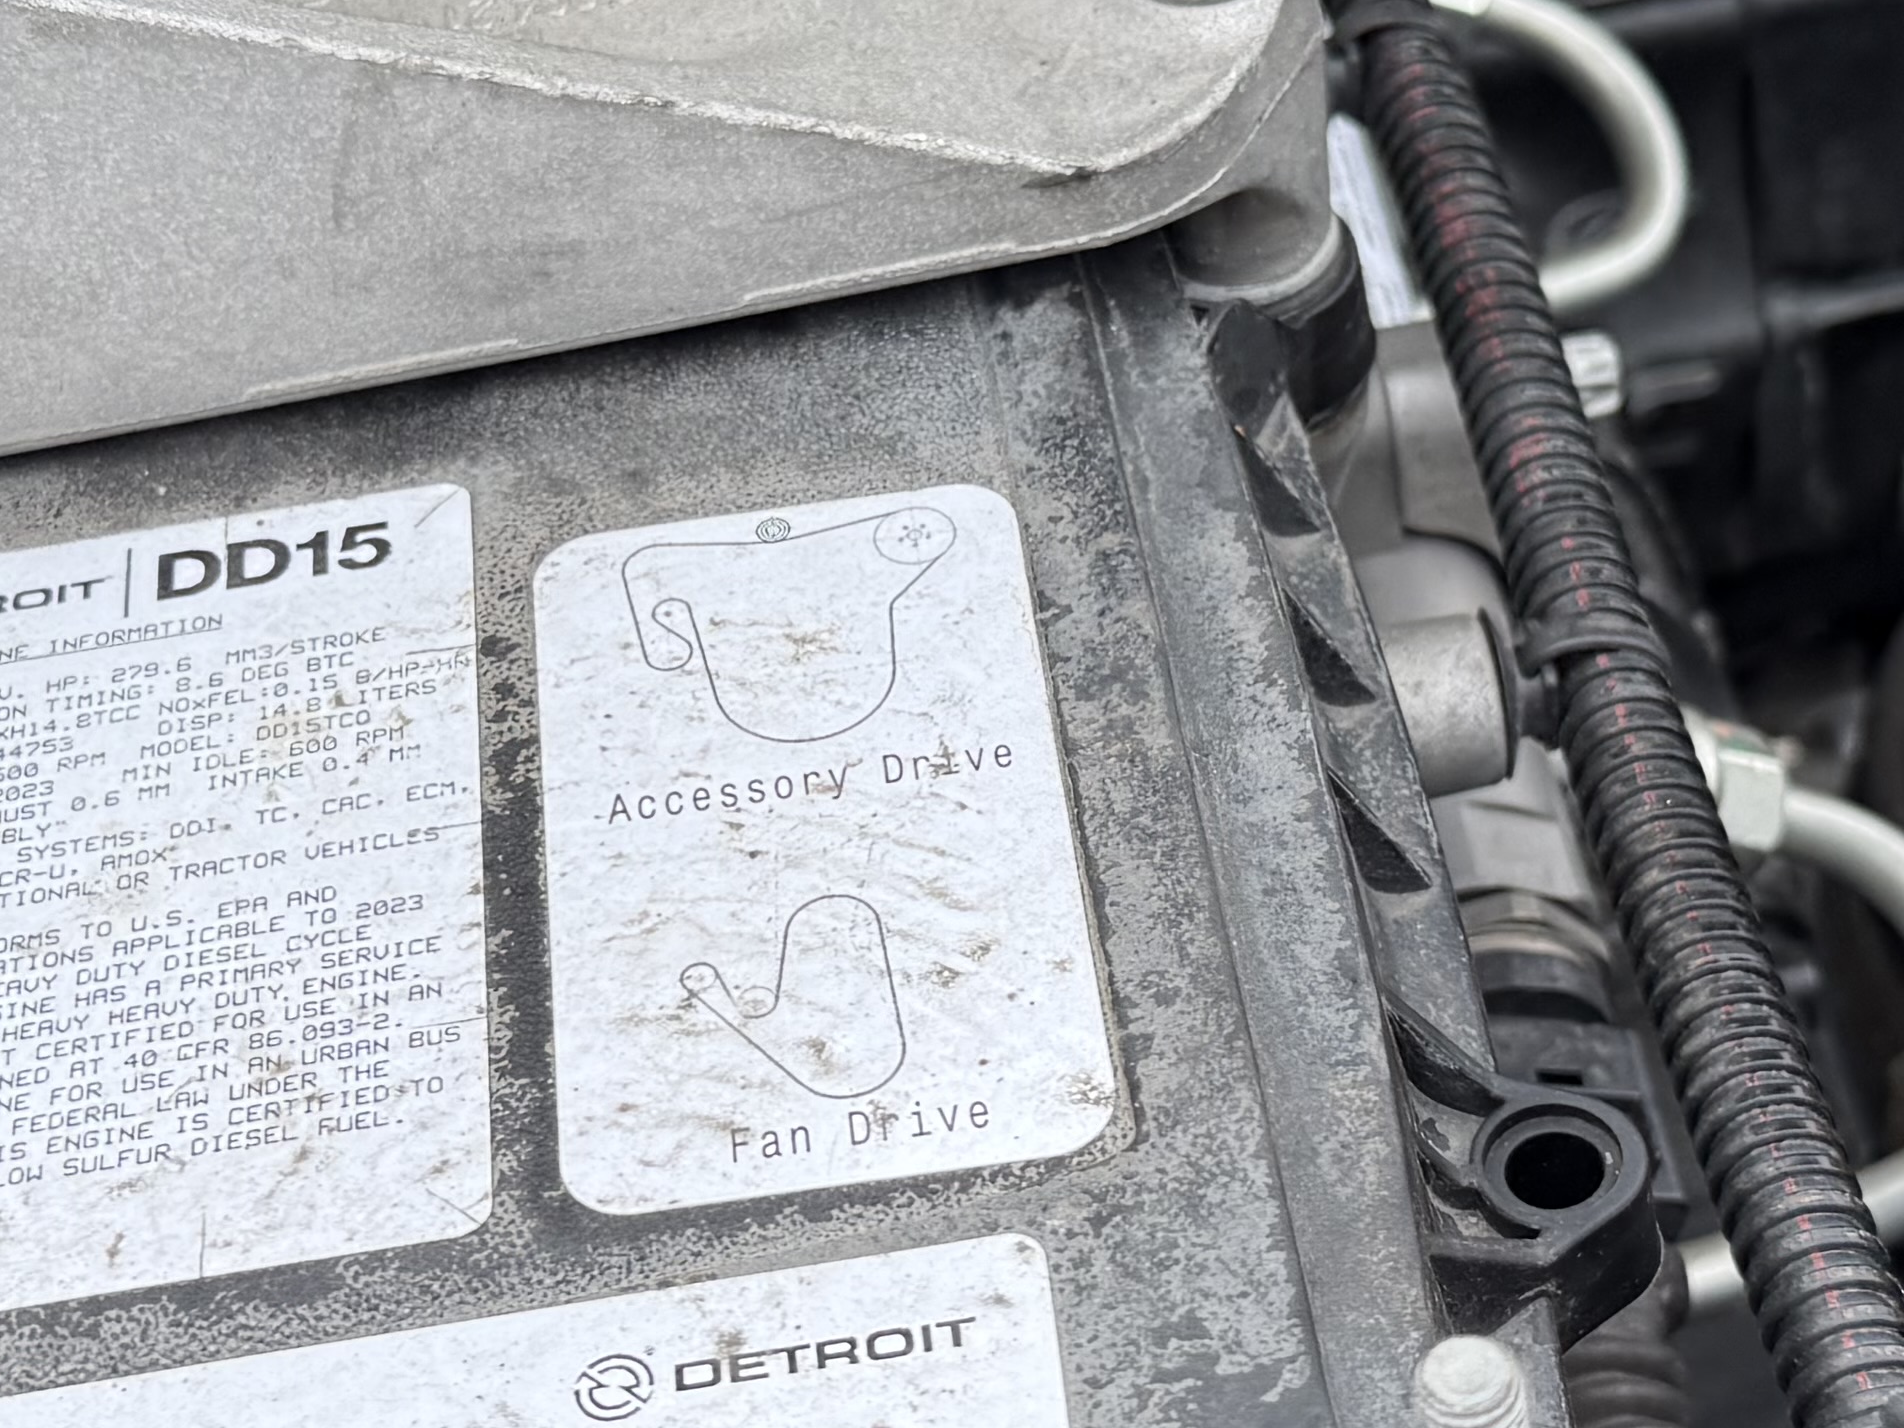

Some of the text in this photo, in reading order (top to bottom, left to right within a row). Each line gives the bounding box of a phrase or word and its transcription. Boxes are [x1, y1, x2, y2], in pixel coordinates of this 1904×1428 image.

[156, 520, 392, 600] DD15
[46, 674, 90, 694] HP:
[111, 658, 191, 684] 279.6
[225, 626, 386, 665] MM3/STROKE
[49, 613, 224, 655] INFORMATION
[44, 683, 154, 714] TIMING:
[175, 672, 222, 693] 8.6
[241, 662, 288, 682] DEG
[306, 651, 353, 672] BTC
[157, 710, 235, 736] DISP:
[256, 696, 320, 720] 14.8
[56, 751, 104, 773] RPM
[139, 731, 234, 759] MODEL:
[70, 790, 118, 812] 0.6
[137, 782, 169, 801] MM
[204, 761, 303, 790] INTAKE
[322, 750, 370, 771] 0.4
[121, 761, 170, 783] MIN
[188, 746, 267, 772] IDLE:
[288, 735, 336, 756] 600
[355, 724, 403, 745] RPM
[607, 735, 1013, 833] Accessory Drive
[16, 828, 147, 863] SYSTEMS:
[115, 870, 147, 890] OR
[166, 848, 284, 882] TRACTOR
[78, 920, 111, 940] TO
[130, 907, 194, 932] U.S.
[216, 895, 266, 918] EPA
[286, 884, 335, 907] AND
[111, 915, 283, 957] APPLICABLE
[355, 892, 422, 918] 2023
[73, 985, 124, 1009] HAS
[179, 957, 300, 992] PRIMARY
[320, 934, 440, 969] SERVICE
[75, 960, 143, 985] DUTY
[162, 940, 265, 971] DIESEL
[285, 923, 370, 952] CYCLE
[1, 1014, 88, 1043] HEAVY
[107, 997, 193, 1026] HEAVY
[302, 961, 420, 995] ENGINE.
[35, 1020, 193, 1061] CERTIFIED
[212, 1009, 264, 1033] FOR
[284, 998, 334, 1021] USE
[49, 1082, 101, 1106] FOR
[121, 1071, 173, 1095] USE
[301, 1036, 388, 1066] URBAN
[409, 1024, 460, 1048] BUS
[122, 1050, 156, 1071] 40
[176, 1038, 227, 1062] CFR
[247, 1010, 403, 1051] 86.093-2.
[11, 1100, 136, 1136] FEDERAL
[156, 1089, 208, 1113] LAW
[228, 1072, 316, 1102] UNDER
[337, 1060, 388, 1084] THE
[46, 1122, 153, 1155] ENGINE
[227, 1084, 388, 1126] CERTIFIED
[730, 1091, 991, 1166] Fan Drive
[62, 1144, 170, 1177] SULFUR
[190, 1123, 297, 1157] DIESEL
[318, 1106, 404, 1136] FUEL.
[674, 1315, 978, 1393] DETROIT
